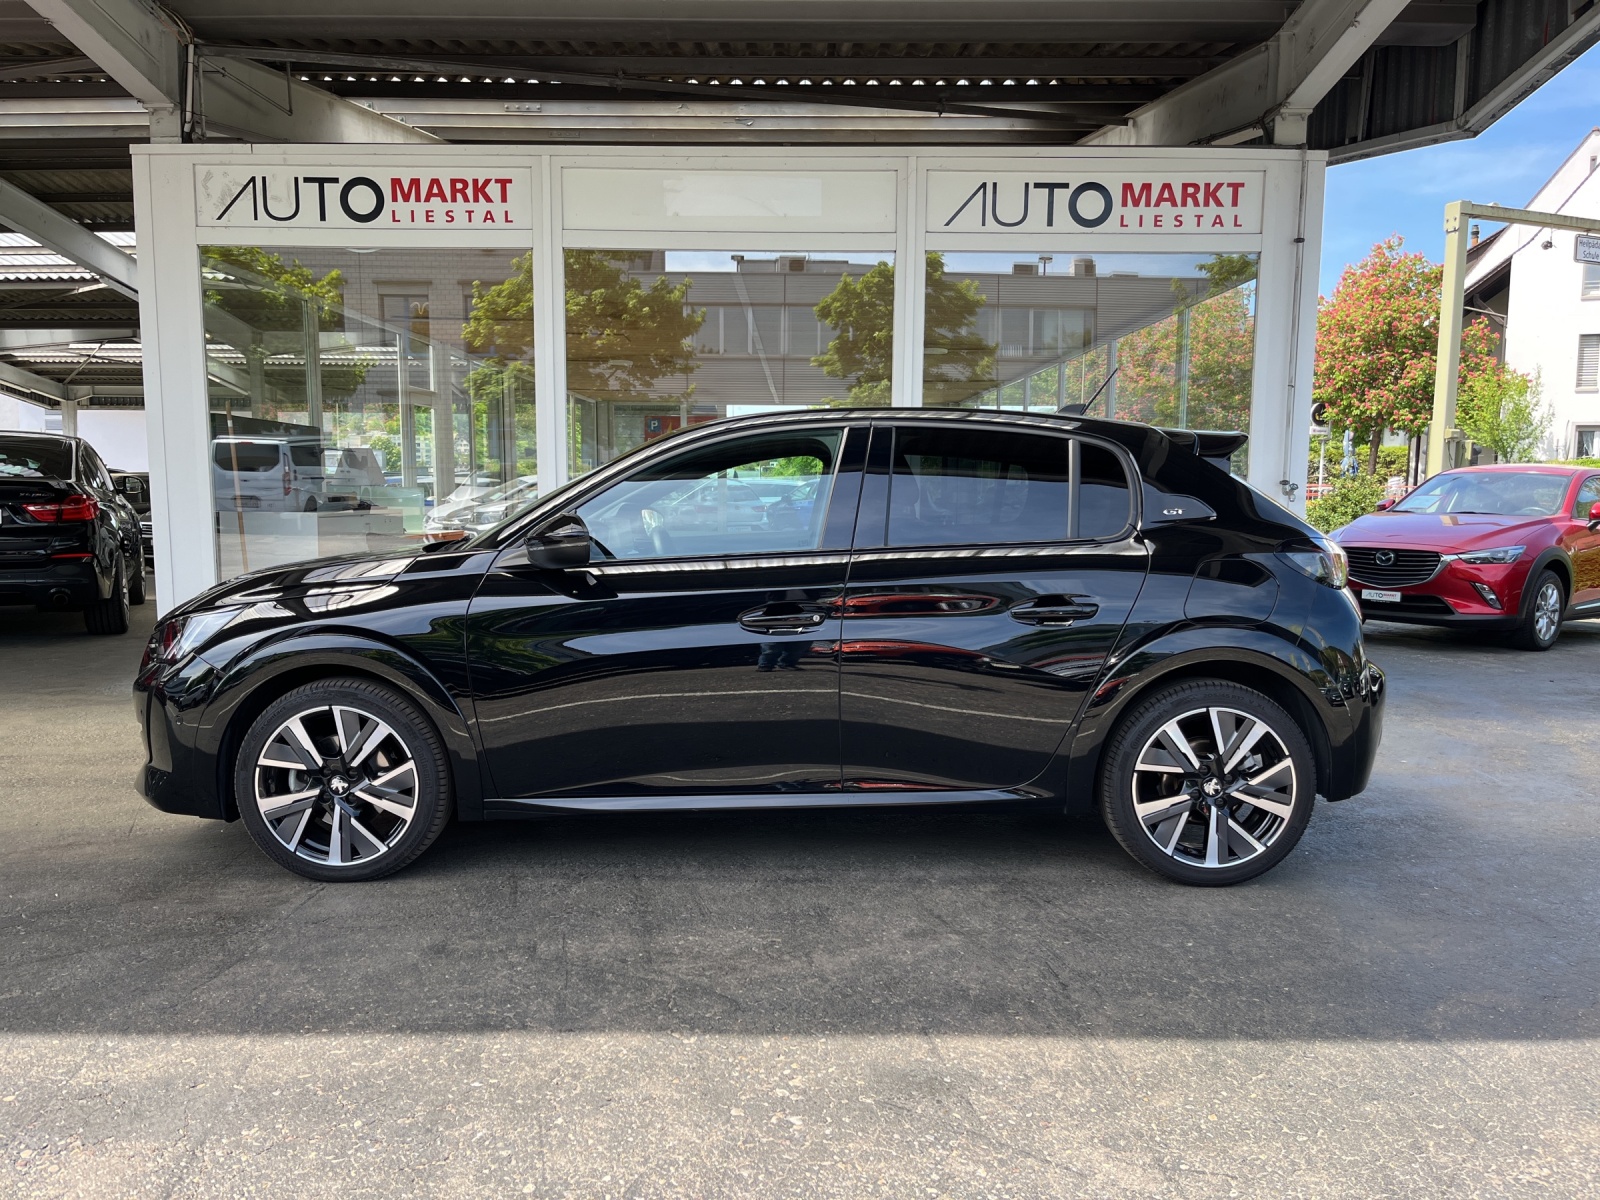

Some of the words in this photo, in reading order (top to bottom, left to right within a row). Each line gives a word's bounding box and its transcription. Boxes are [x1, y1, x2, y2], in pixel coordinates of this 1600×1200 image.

[215, 175, 385, 223] AUTO
[390, 177, 513, 204] MARKT
[943, 181, 1113, 228] AUTO
[1120, 182, 1245, 208] MARKT
[391, 209, 514, 223] LIESTAL
[1119, 214, 1243, 228] LIESTAL
[1583, 250, 1599, 260] Schule
[651, 420, 658, 430] P
[1130, 711, 1165, 750] Continental
[414, 743, 433, 788] Continental
